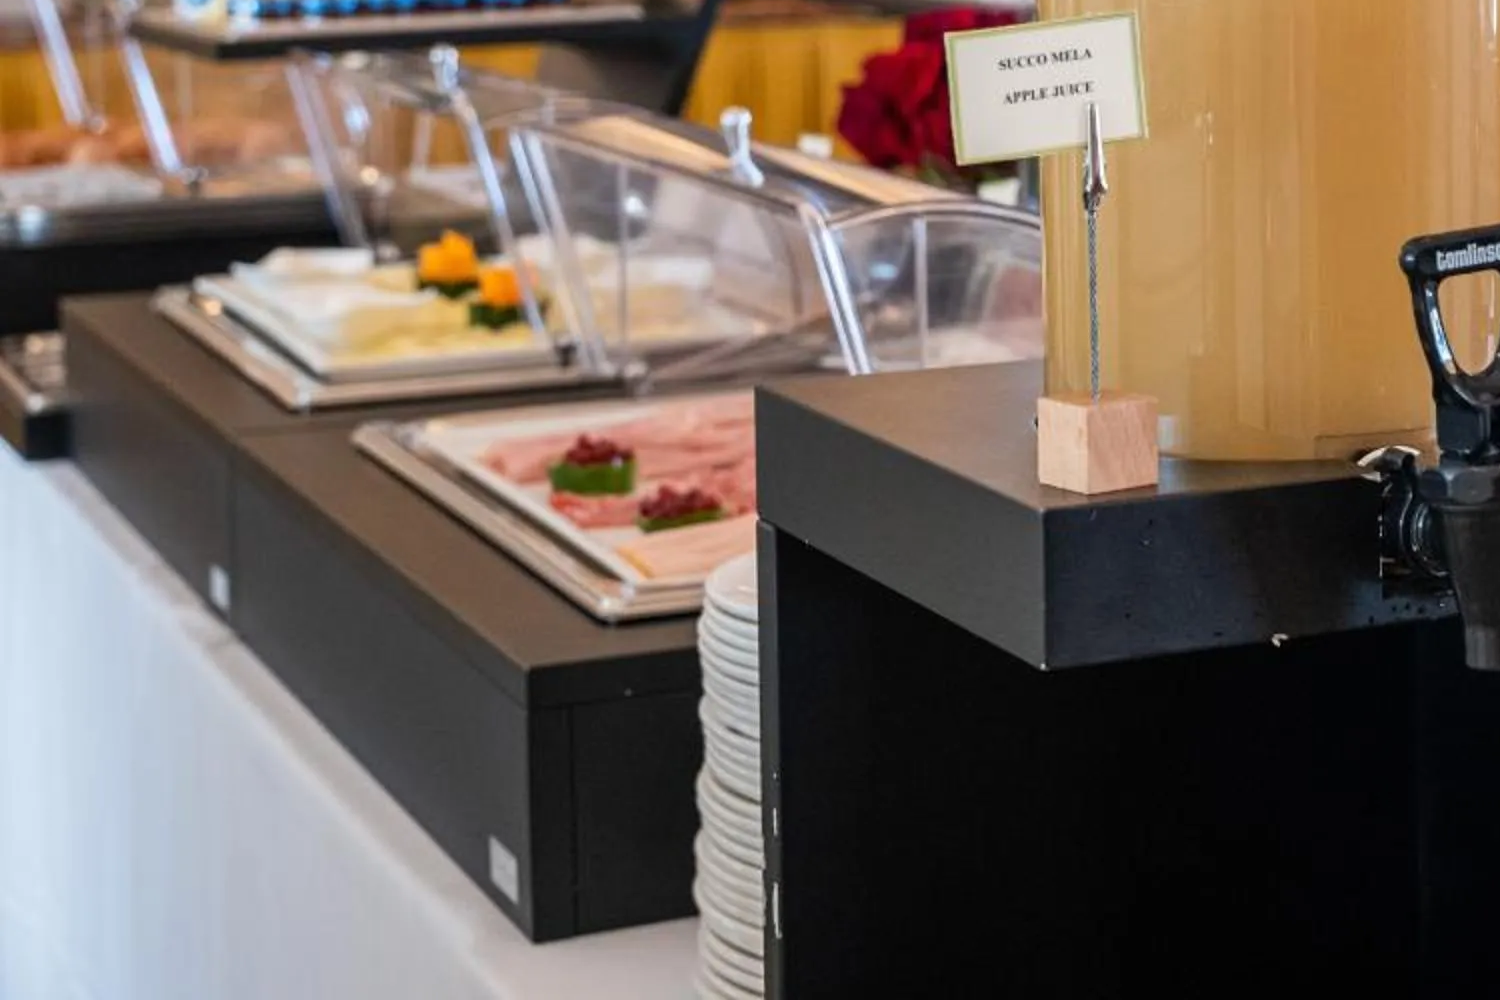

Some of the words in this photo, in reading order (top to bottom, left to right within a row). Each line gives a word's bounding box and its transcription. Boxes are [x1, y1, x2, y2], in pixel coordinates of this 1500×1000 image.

[998, 52, 1048, 71] SUCCO
[1052, 48, 1093, 64] MELA
[1003, 87, 1049, 105] APPLE
[1052, 81, 1095, 99] JUICE
